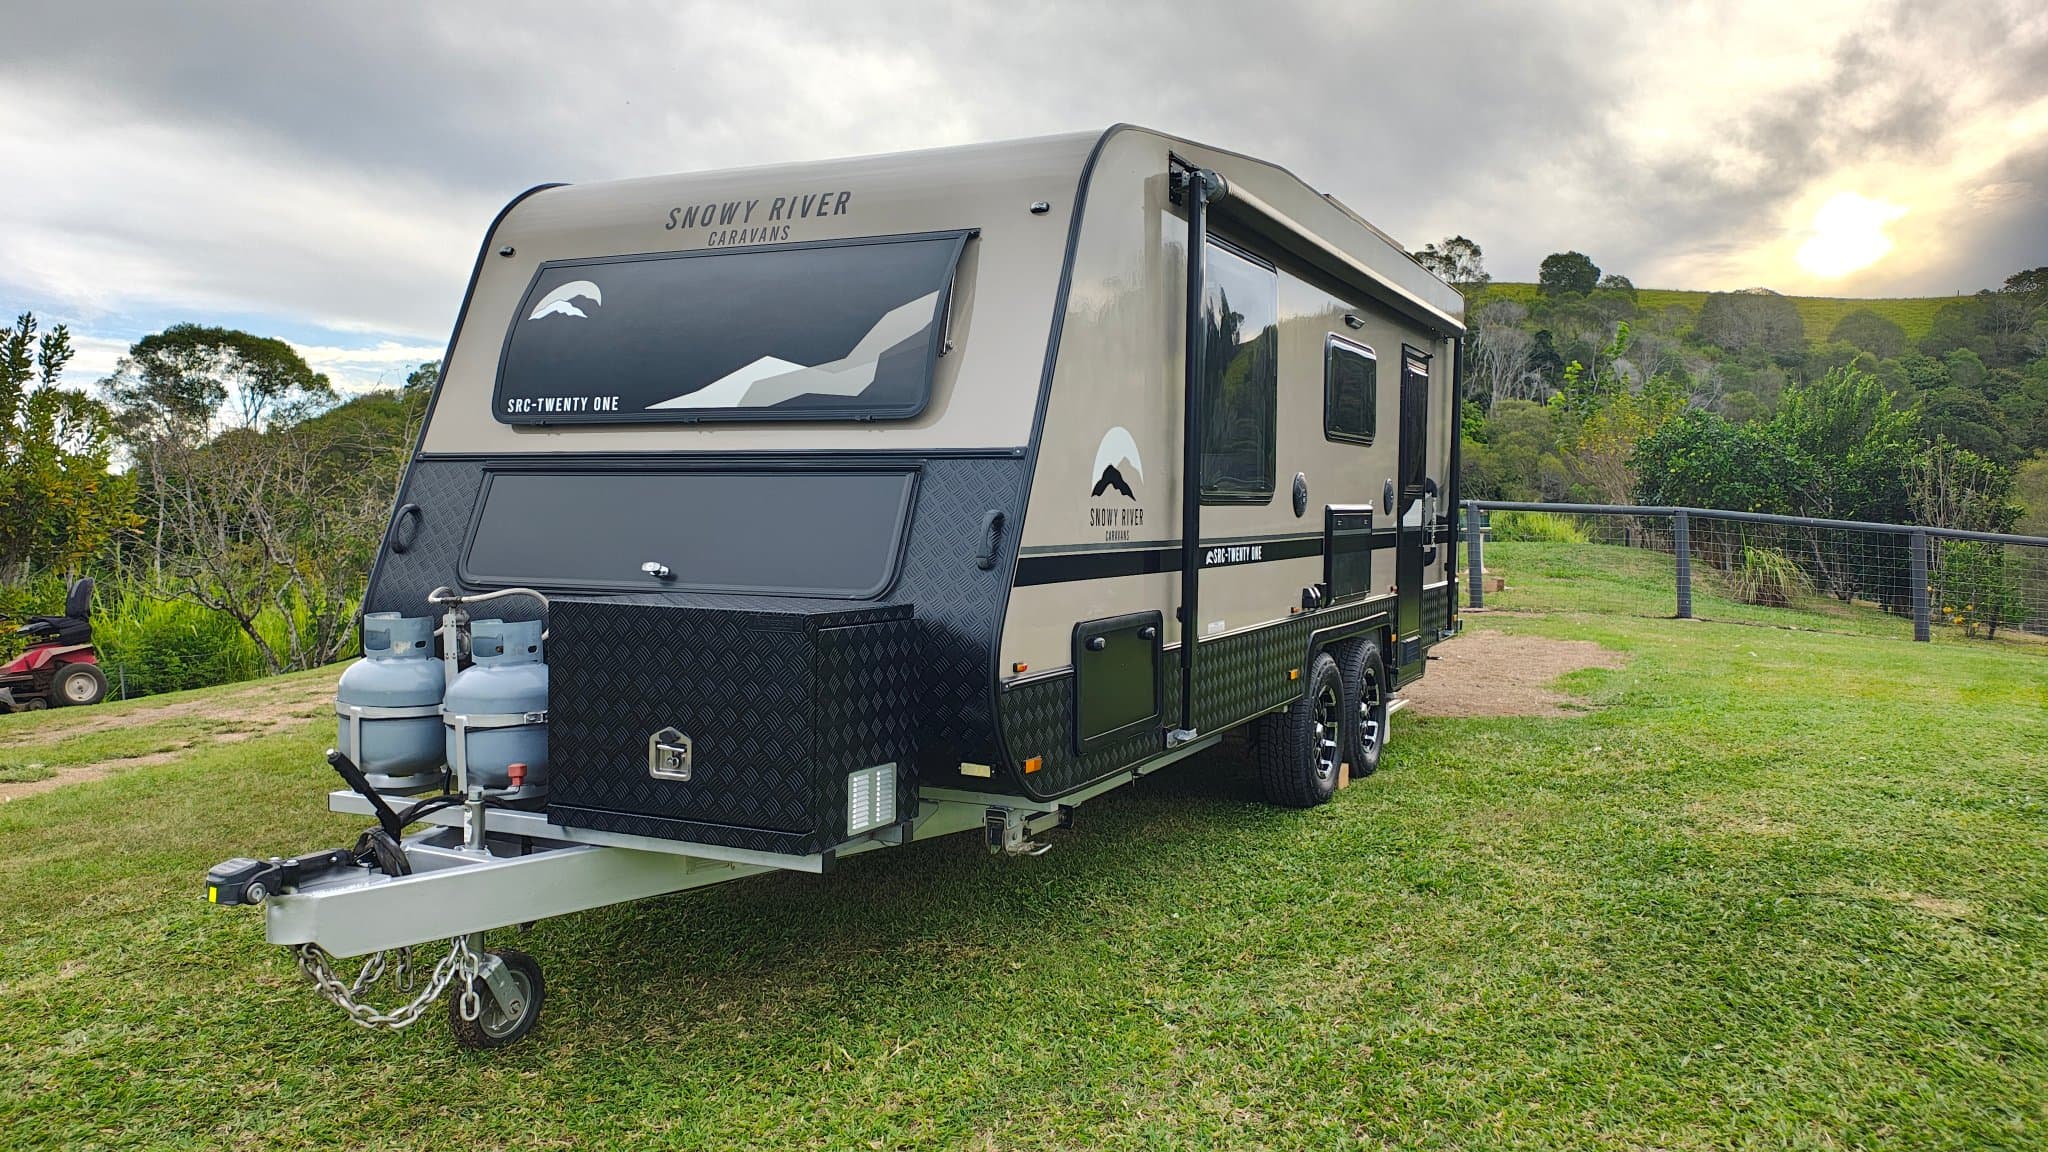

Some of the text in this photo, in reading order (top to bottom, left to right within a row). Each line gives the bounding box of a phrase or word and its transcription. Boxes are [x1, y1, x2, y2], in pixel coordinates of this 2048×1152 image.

[665, 191, 851, 231] SNOWY RIVER
[708, 225, 791, 247] CARAVANS
[507, 396, 619, 412] SRC-TWENTY ONE
[1090, 508, 1144, 527] SNOWY RIVER
[1105, 530, 1129, 542] CARAVANS
[1213, 545, 1262, 564] SRC-TWENTY ONE
